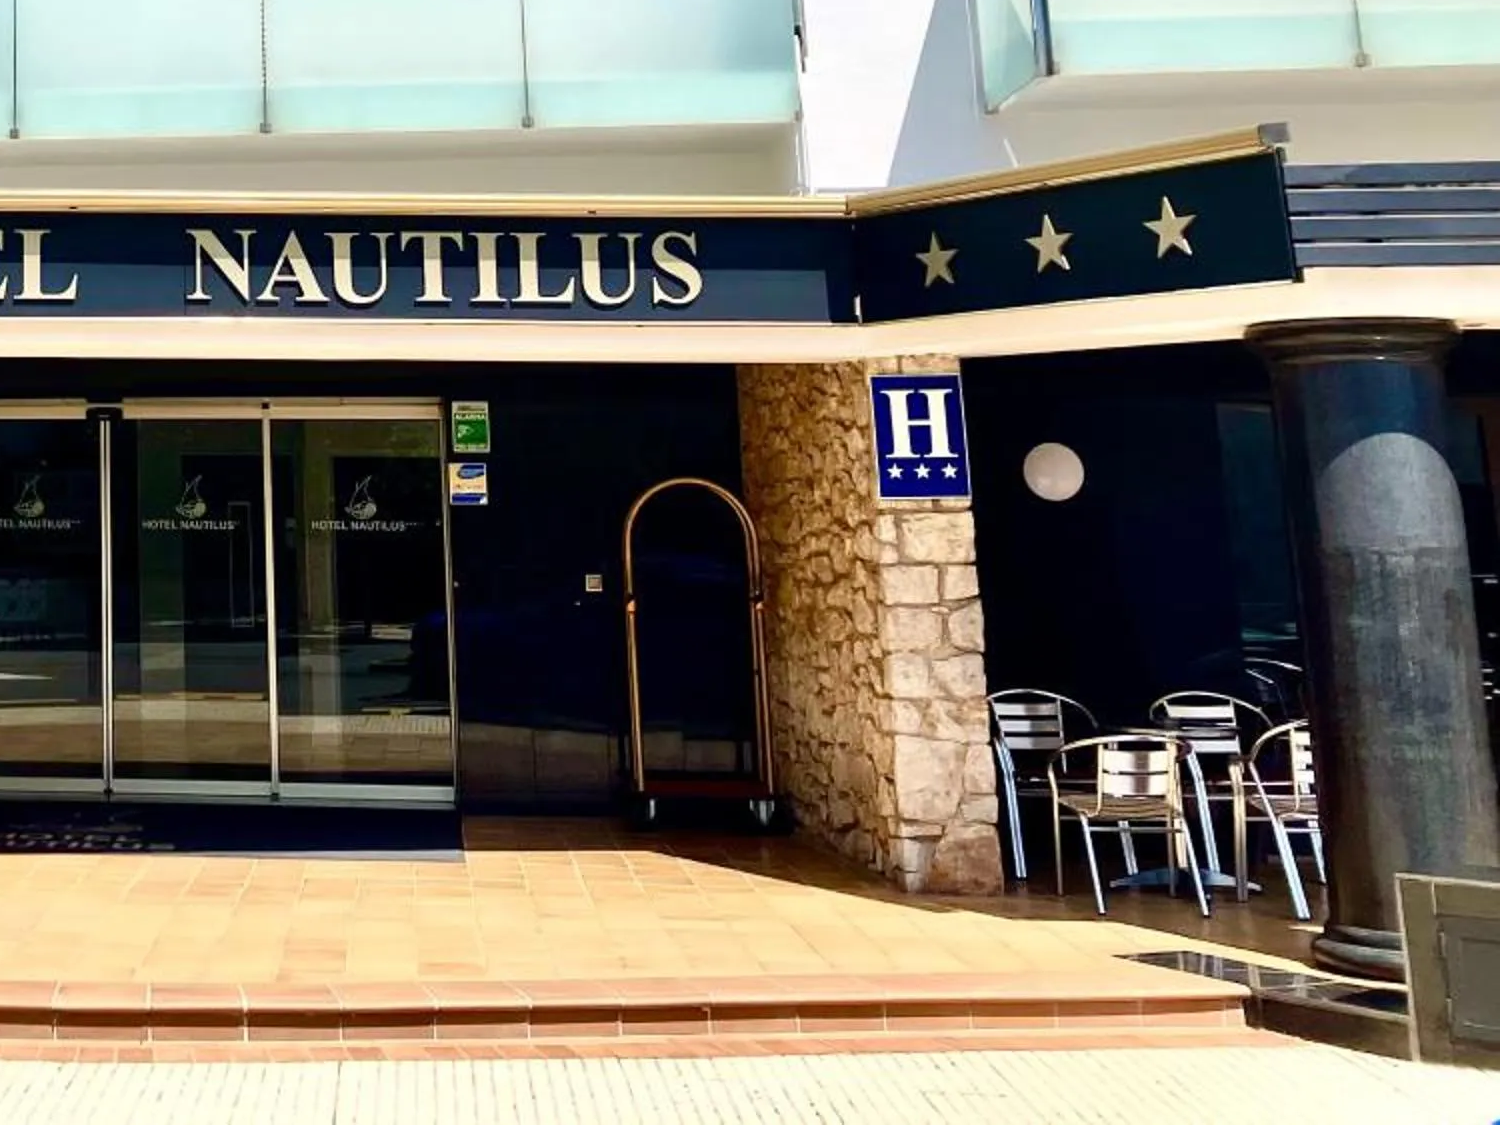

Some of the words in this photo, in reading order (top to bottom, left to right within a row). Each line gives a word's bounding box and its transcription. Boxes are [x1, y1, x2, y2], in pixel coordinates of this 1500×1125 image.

[184, 228, 705, 307] NAUTILUS
[879, 388, 960, 459] H
[18, 518, 71, 530] NAUTILUS
[141, 519, 176, 530] HOTEL
[180, 519, 235, 530] NAUTILUS
[311, 520, 348, 531] HOTEL
[351, 520, 406, 532] NAUTILUS
